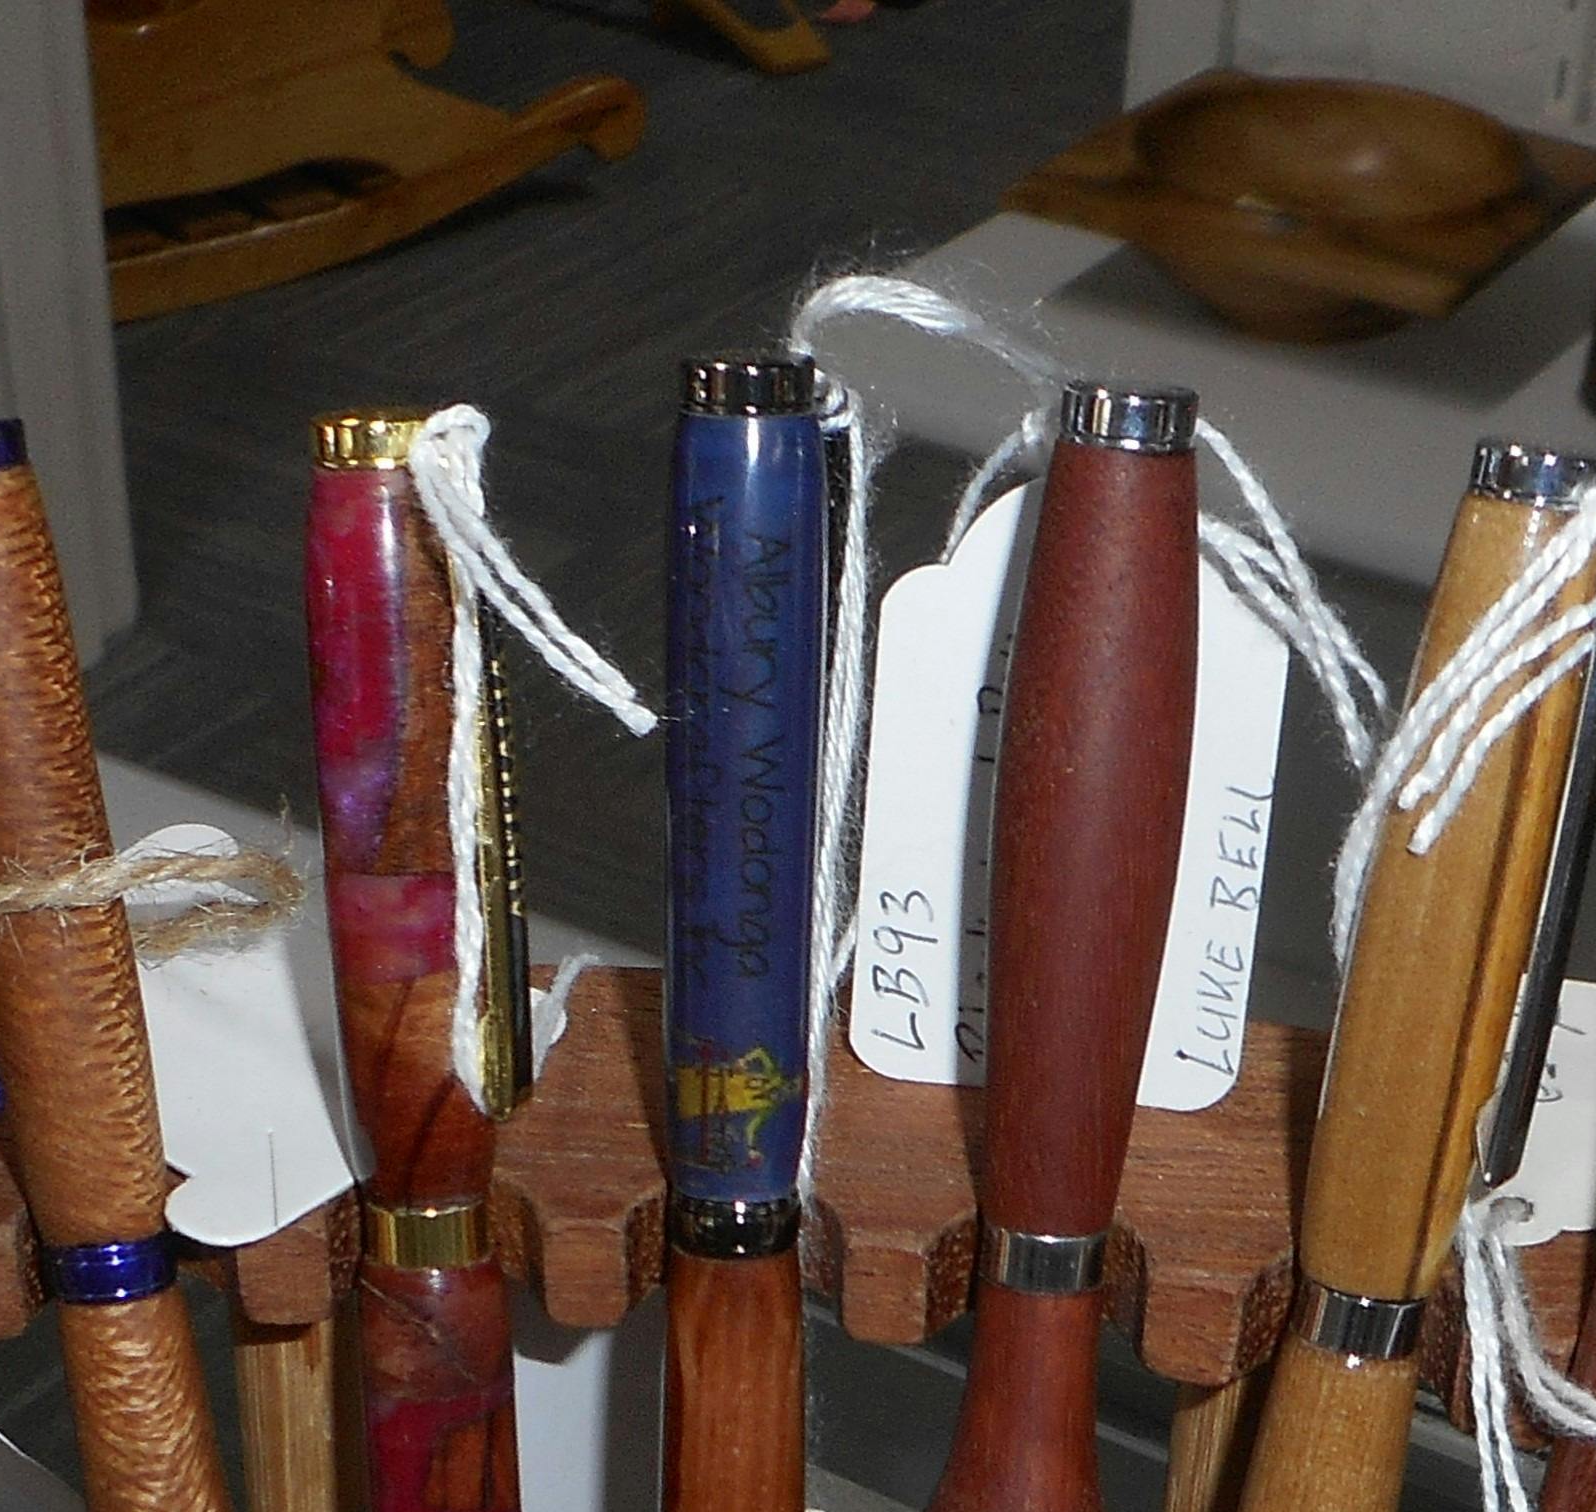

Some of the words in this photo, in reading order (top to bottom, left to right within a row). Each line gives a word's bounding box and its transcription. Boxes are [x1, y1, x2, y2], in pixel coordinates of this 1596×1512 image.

[720, 530, 792, 709] Albury
[717, 731, 790, 981] Wodonga
[870, 887, 940, 1053] LB93
[1174, 943, 1249, 1078] LUKE
